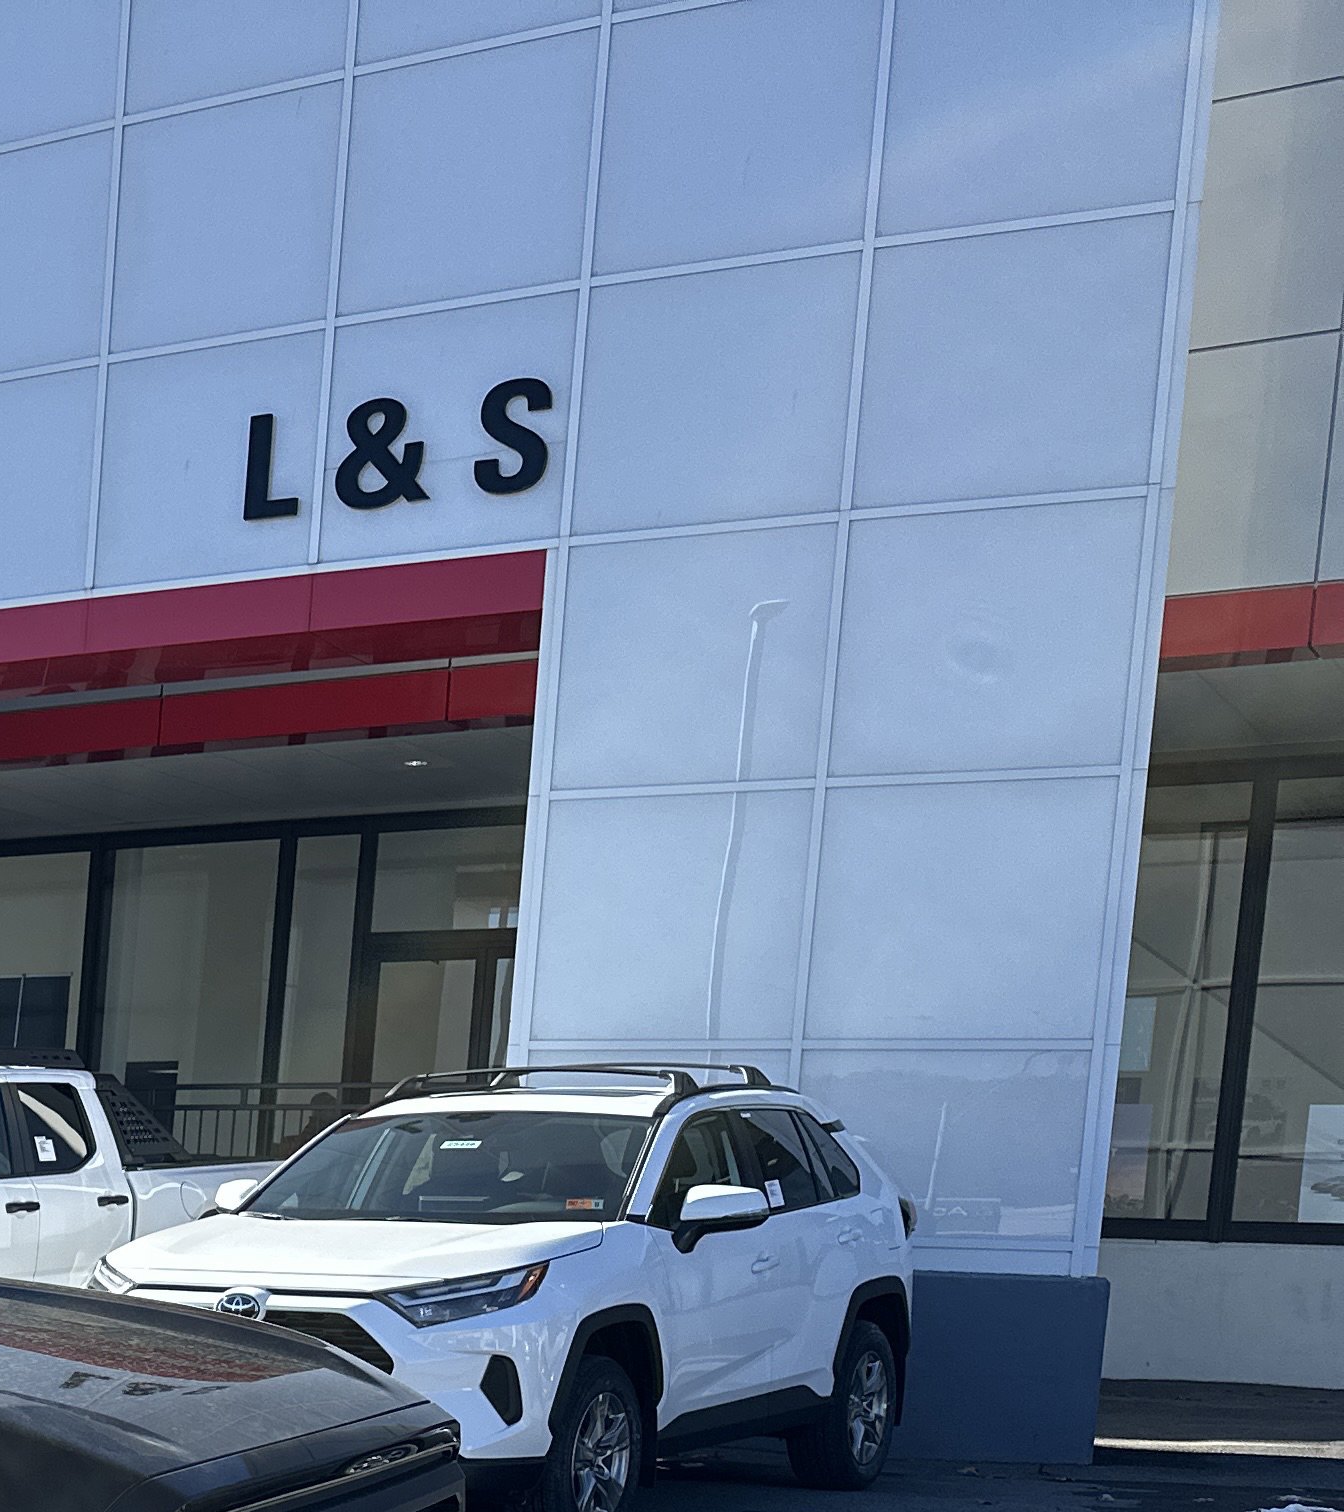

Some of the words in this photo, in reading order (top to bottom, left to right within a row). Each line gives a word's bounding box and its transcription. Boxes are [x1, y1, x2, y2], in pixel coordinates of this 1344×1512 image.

[243, 413, 299, 521] L
[334, 397, 431, 510] &
[473, 377, 553, 495] S
